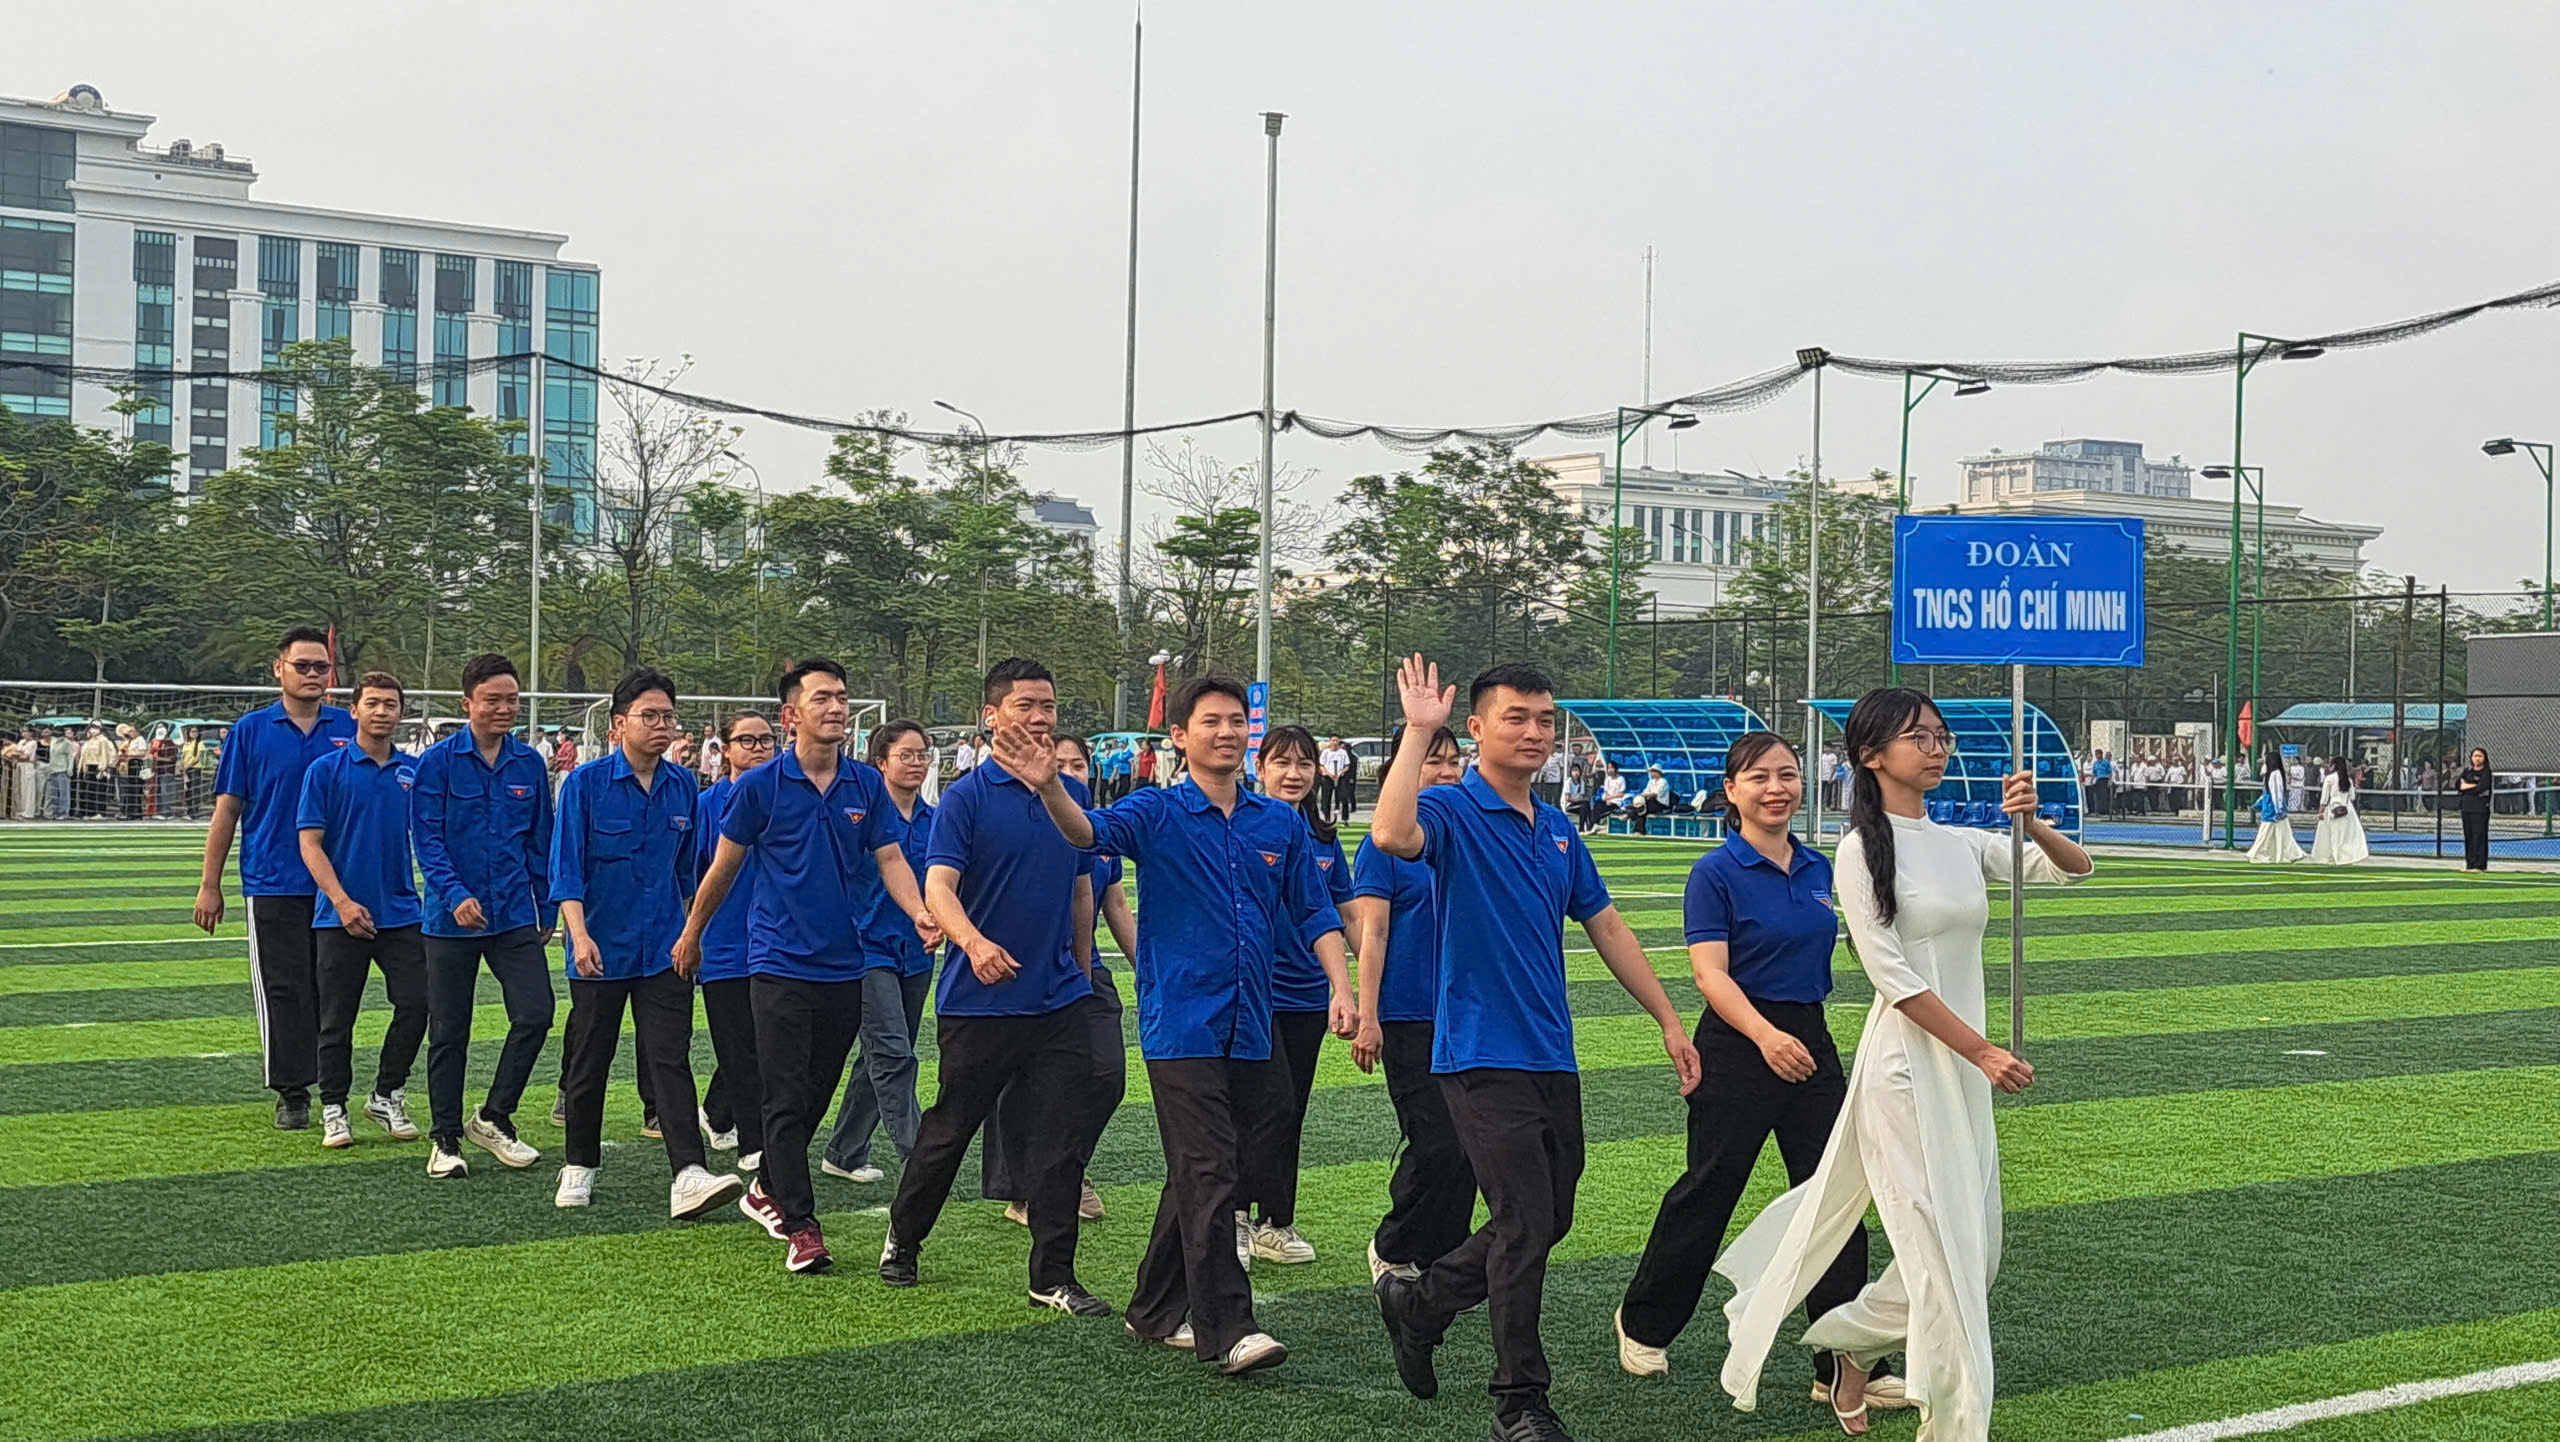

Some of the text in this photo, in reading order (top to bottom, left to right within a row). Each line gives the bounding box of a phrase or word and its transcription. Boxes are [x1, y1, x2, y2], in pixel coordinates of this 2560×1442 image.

[1966, 534, 2073, 567] ĐOÀN
[1913, 575, 2126, 631] TNCS HỒ CHÍ MINH
